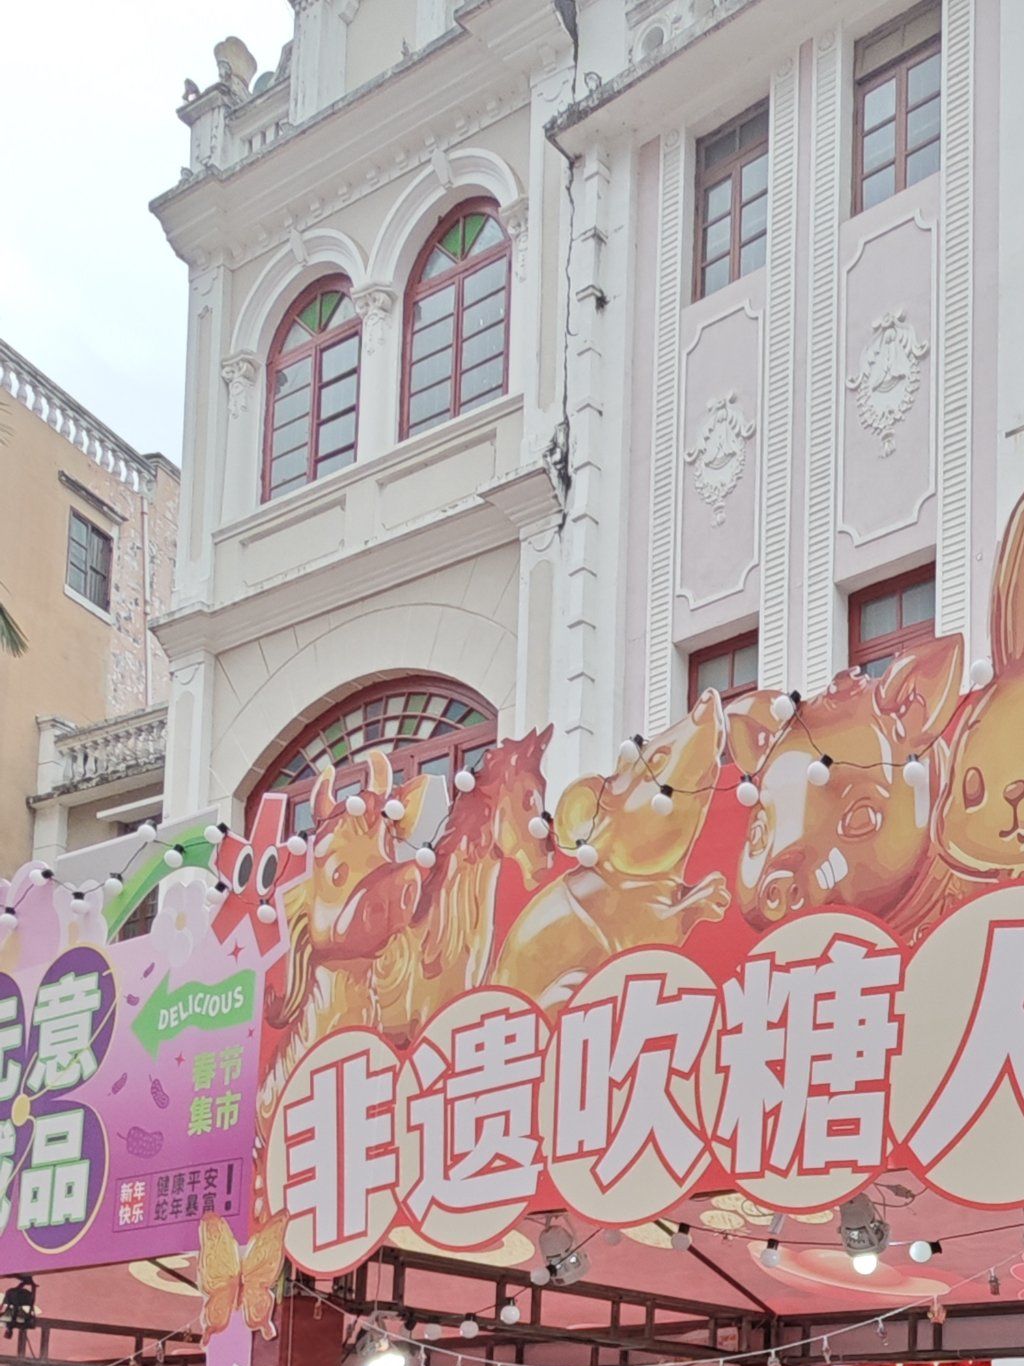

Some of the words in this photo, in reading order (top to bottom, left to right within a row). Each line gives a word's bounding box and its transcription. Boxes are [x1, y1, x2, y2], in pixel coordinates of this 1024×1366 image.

[158, 986, 244, 1031] DELICIOUS
[193, 1046, 244, 1092] 春节
[187, 1091, 243, 1137] 集市
[120, 1181, 146, 1203] 新年
[156, 1168, 219, 1198] 健康平安
[119, 1202, 144, 1226] 快乐
[154, 1192, 217, 1221] 蛇年暴富
